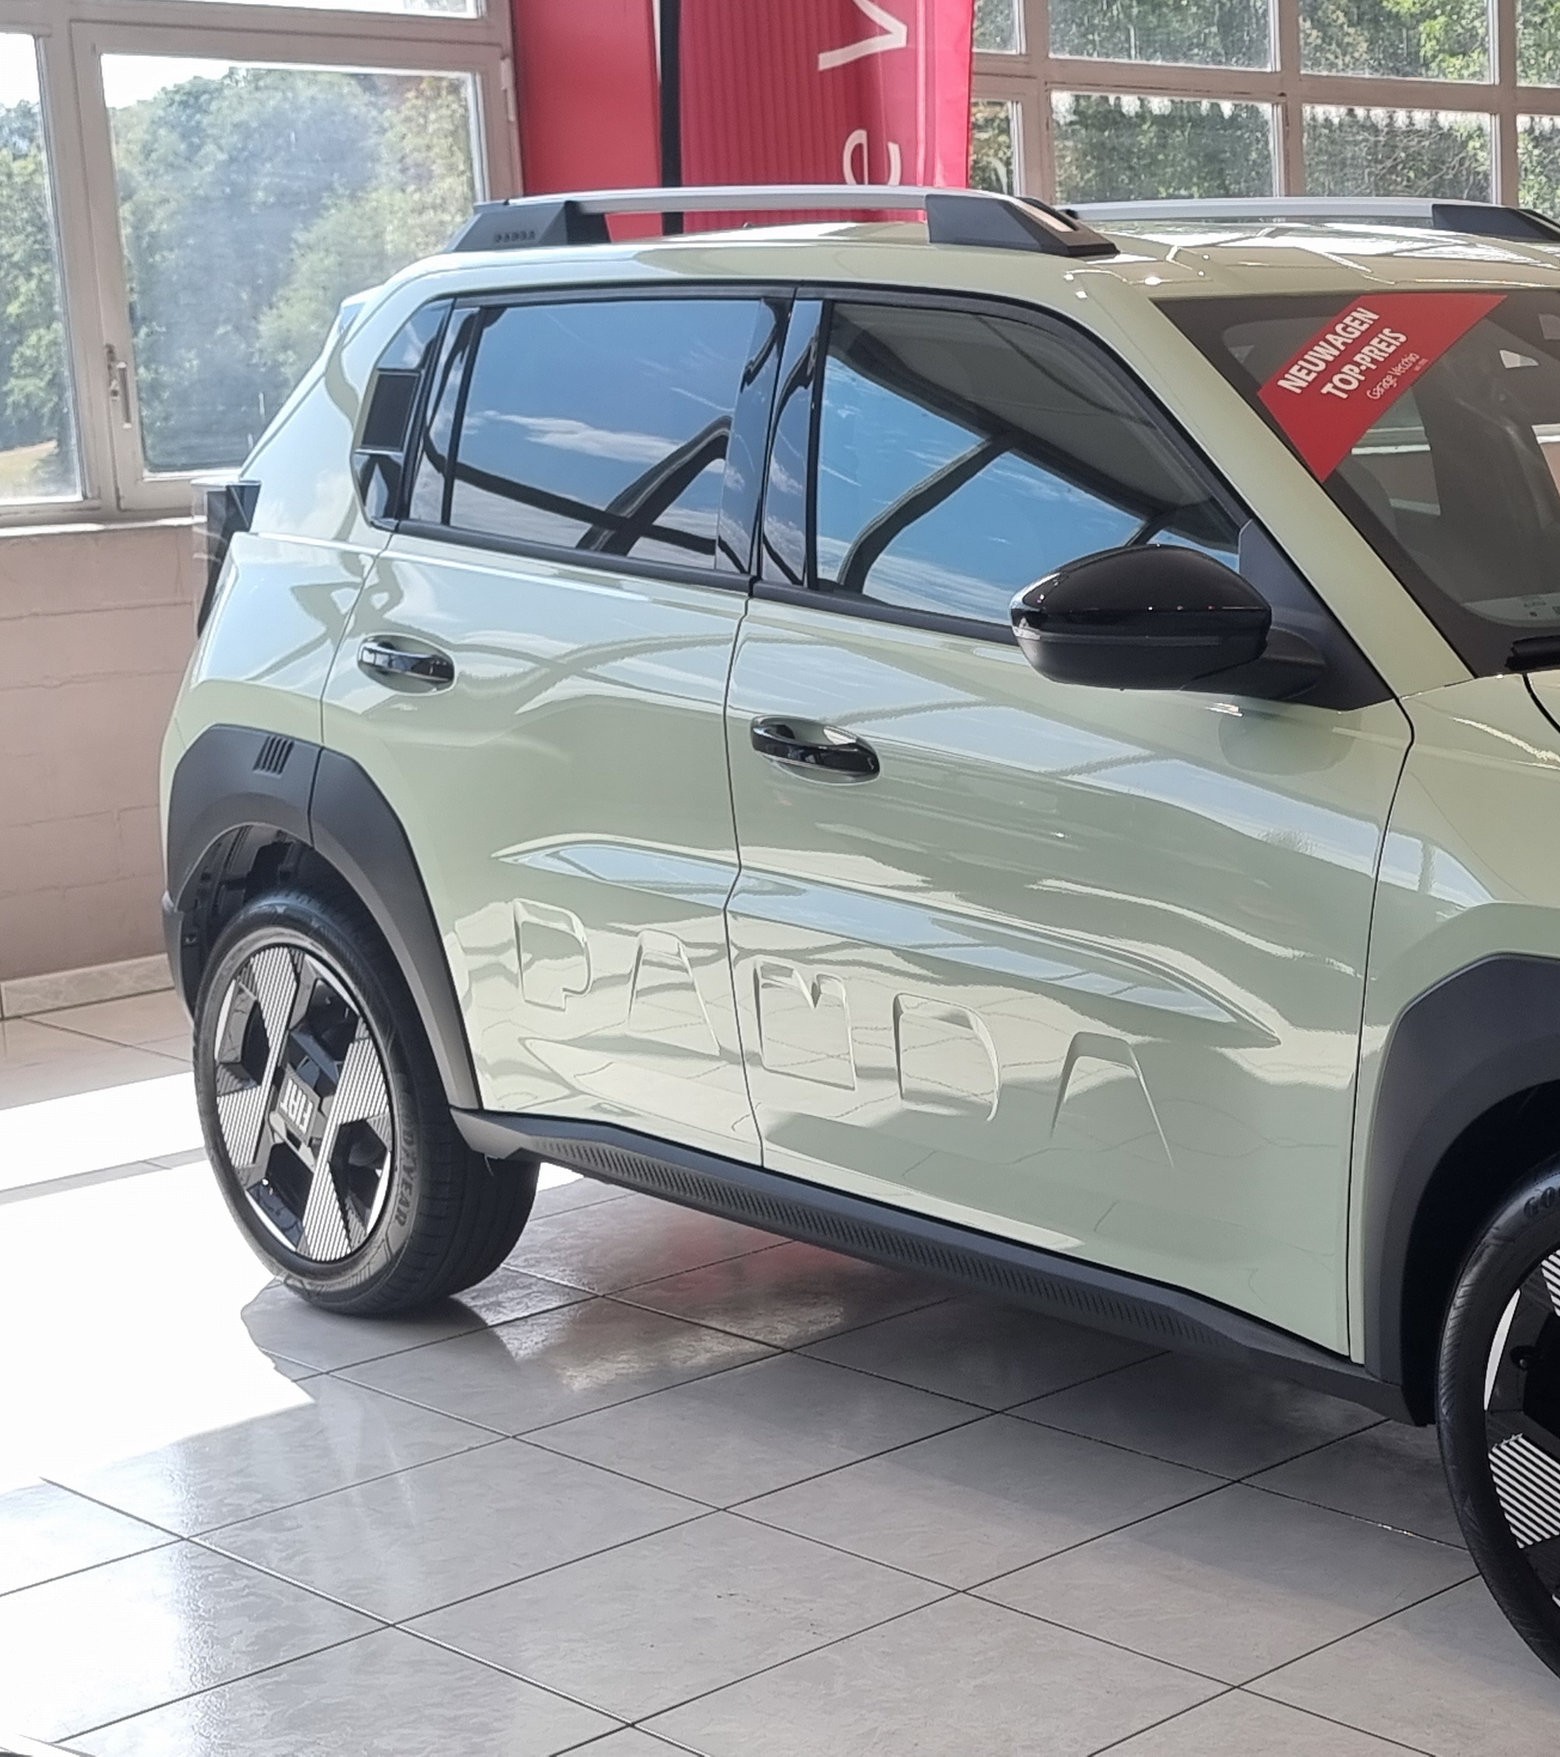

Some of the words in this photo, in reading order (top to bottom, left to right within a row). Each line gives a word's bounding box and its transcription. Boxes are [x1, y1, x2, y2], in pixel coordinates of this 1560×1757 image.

[1277, 307, 1380, 394] NEUWAGEN
[1320, 327, 1408, 400] TOP-PREIS
[1366, 374, 1398, 400] Garage
[1387, 353, 1420, 376] Vecchio
[514, 897, 1175, 1168] PANDA
[280, 1078, 313, 1134] FIAT
